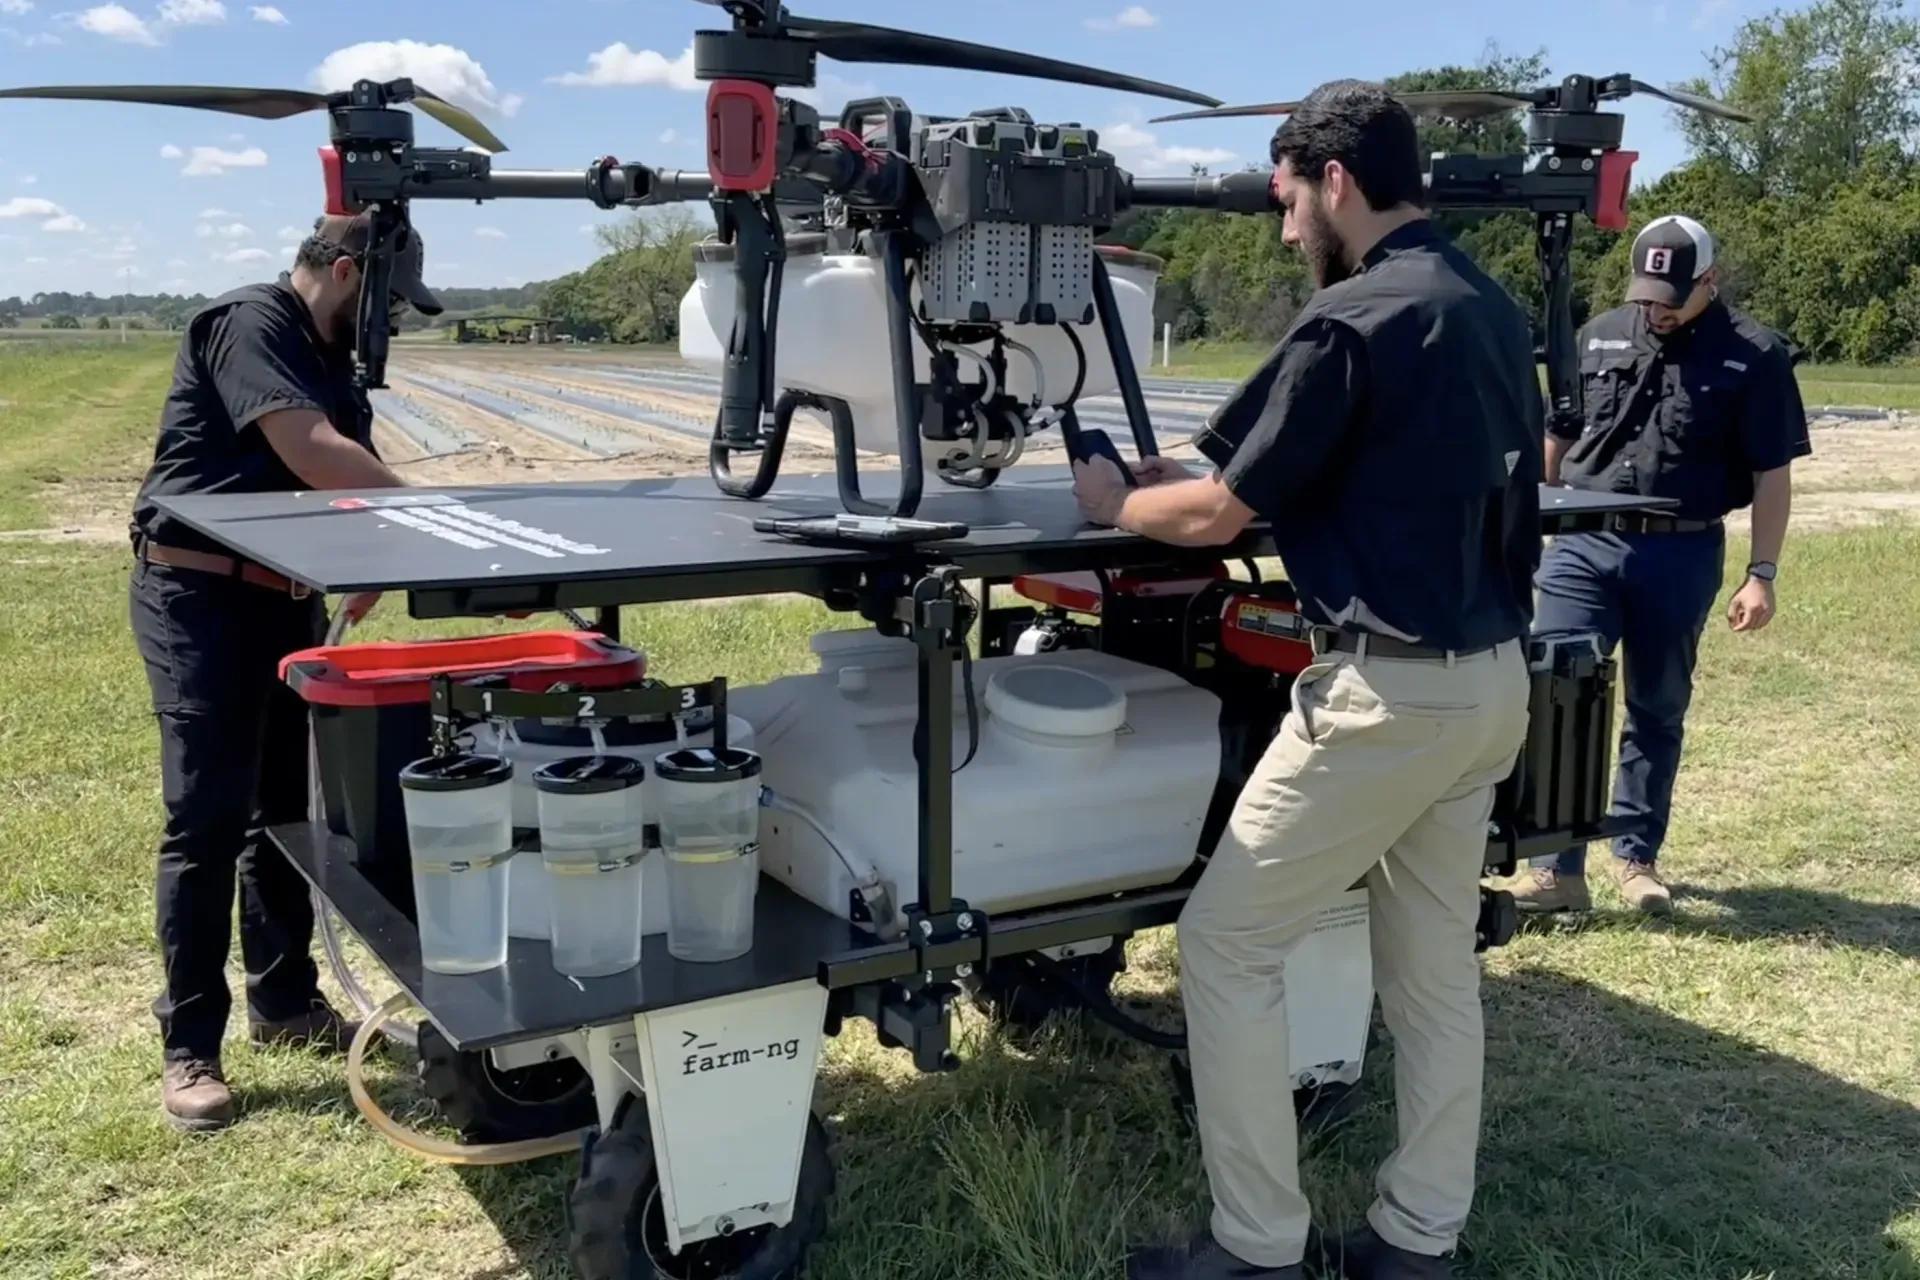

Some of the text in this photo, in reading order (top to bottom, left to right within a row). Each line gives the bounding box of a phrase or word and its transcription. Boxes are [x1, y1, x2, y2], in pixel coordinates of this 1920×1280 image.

[1652, 251, 1665, 270] G
[482, 692, 493, 712] 1
[578, 696, 596, 717] 2
[681, 687, 696, 708] 3
[682, 1038, 800, 1075] farm-ng
